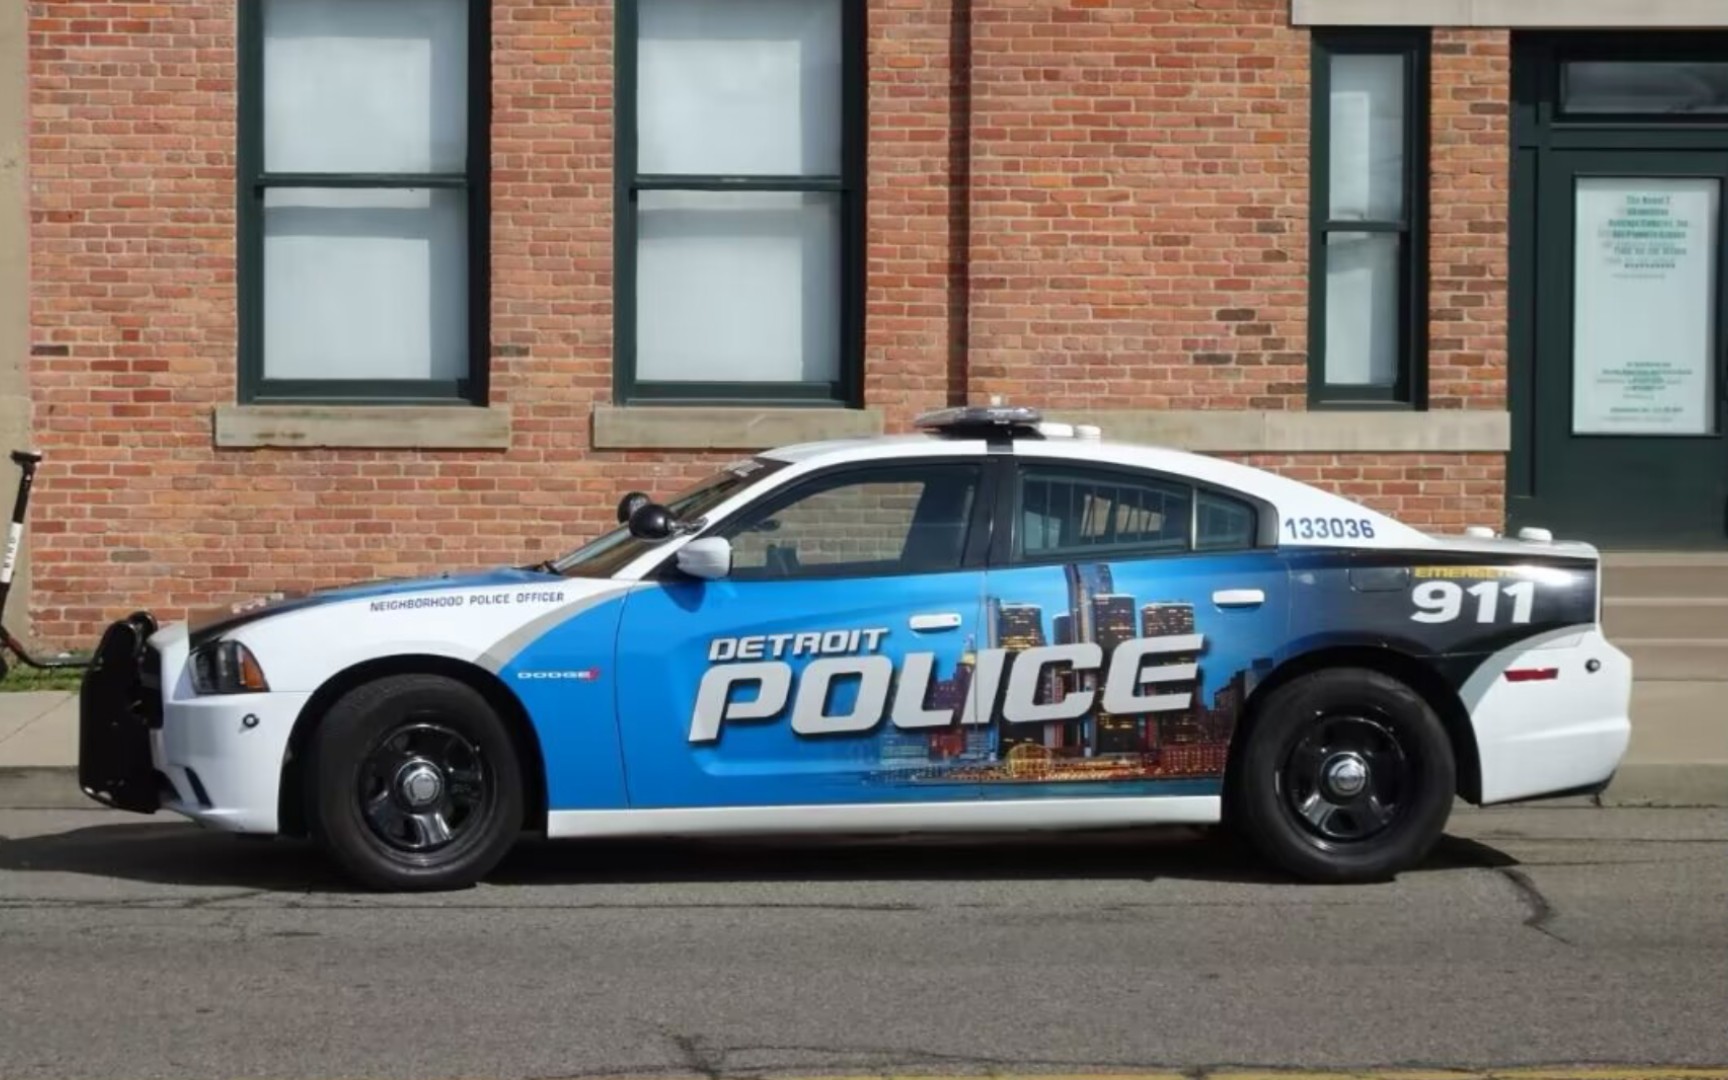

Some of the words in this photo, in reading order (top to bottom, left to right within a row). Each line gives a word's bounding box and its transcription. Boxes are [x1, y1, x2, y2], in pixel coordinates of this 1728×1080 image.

[1285, 518, 1375, 539] 133036
[370, 596, 464, 612] NEIGHBORHOOD
[470, 593, 510, 605] POLICE
[516, 591, 564, 603] OFFICER
[1410, 581, 1534, 624] 911
[708, 627, 889, 662] DETROIT
[688, 634, 1205, 742] POLICE
